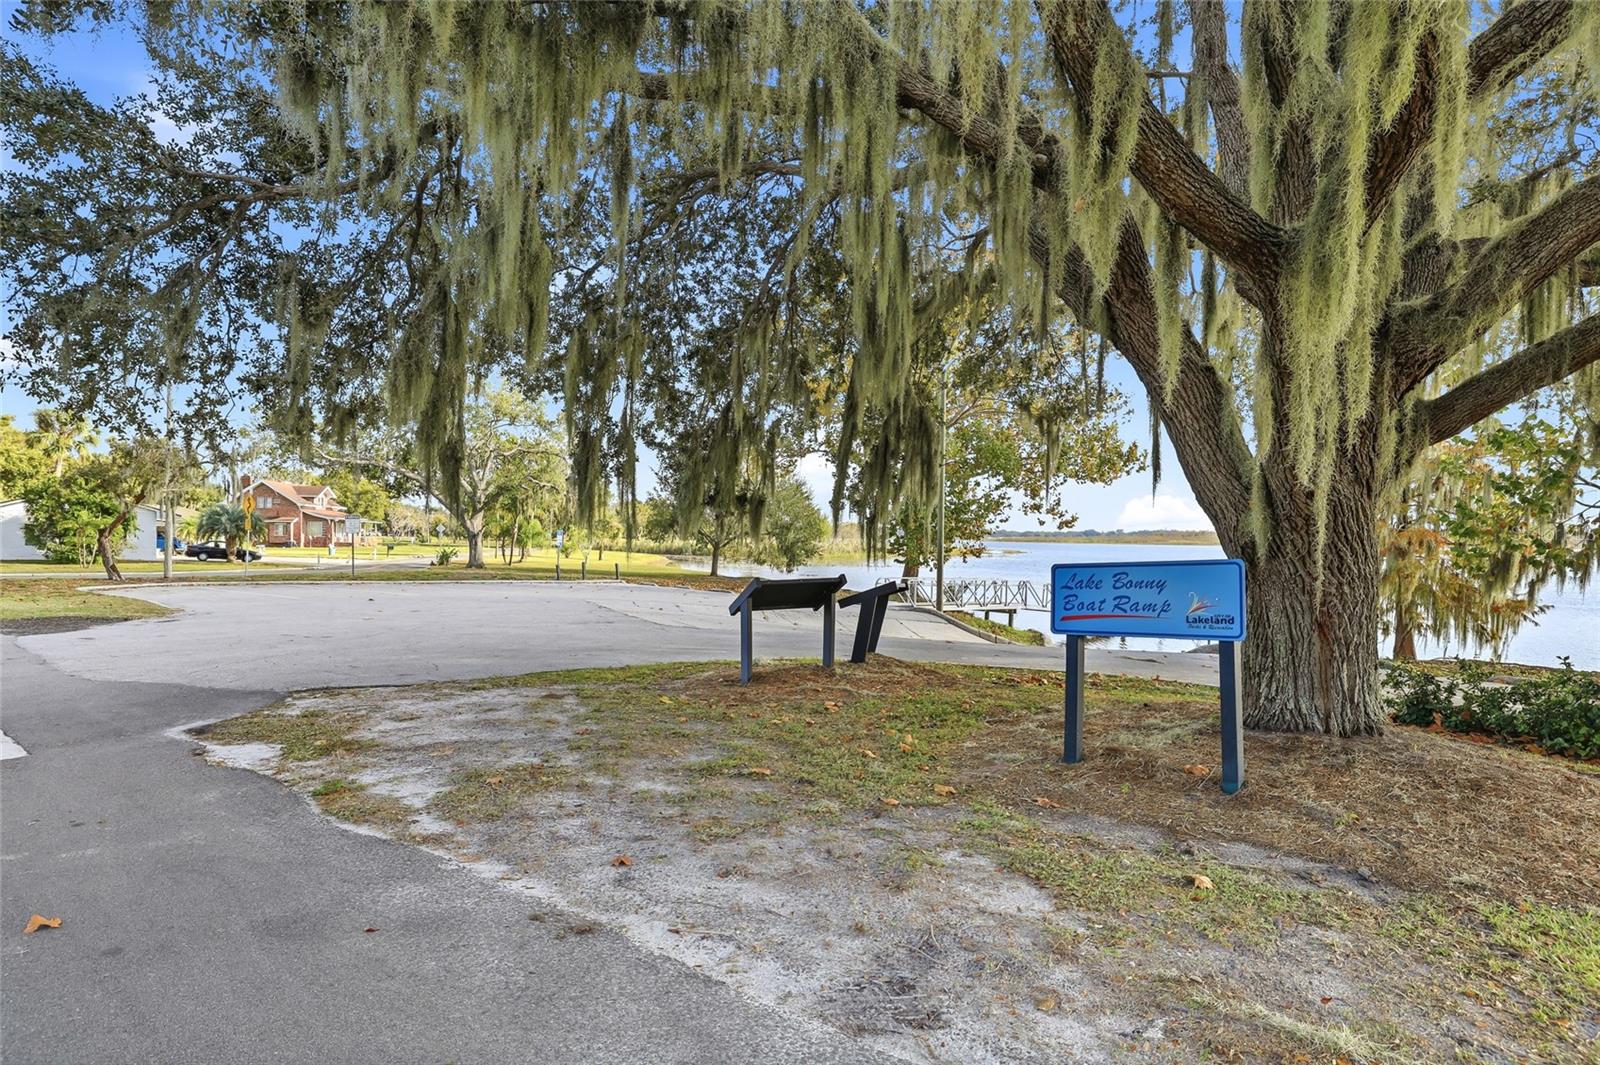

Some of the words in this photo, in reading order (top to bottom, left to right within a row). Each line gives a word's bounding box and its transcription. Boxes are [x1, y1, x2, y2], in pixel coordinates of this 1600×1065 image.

[1060, 573, 1103, 591] Lake
[1112, 572, 1168, 595] Bonny
[1063, 594, 1106, 612] Boat
[1112, 595, 1171, 618] Ramp
[1186, 615, 1235, 624] Lakeland
